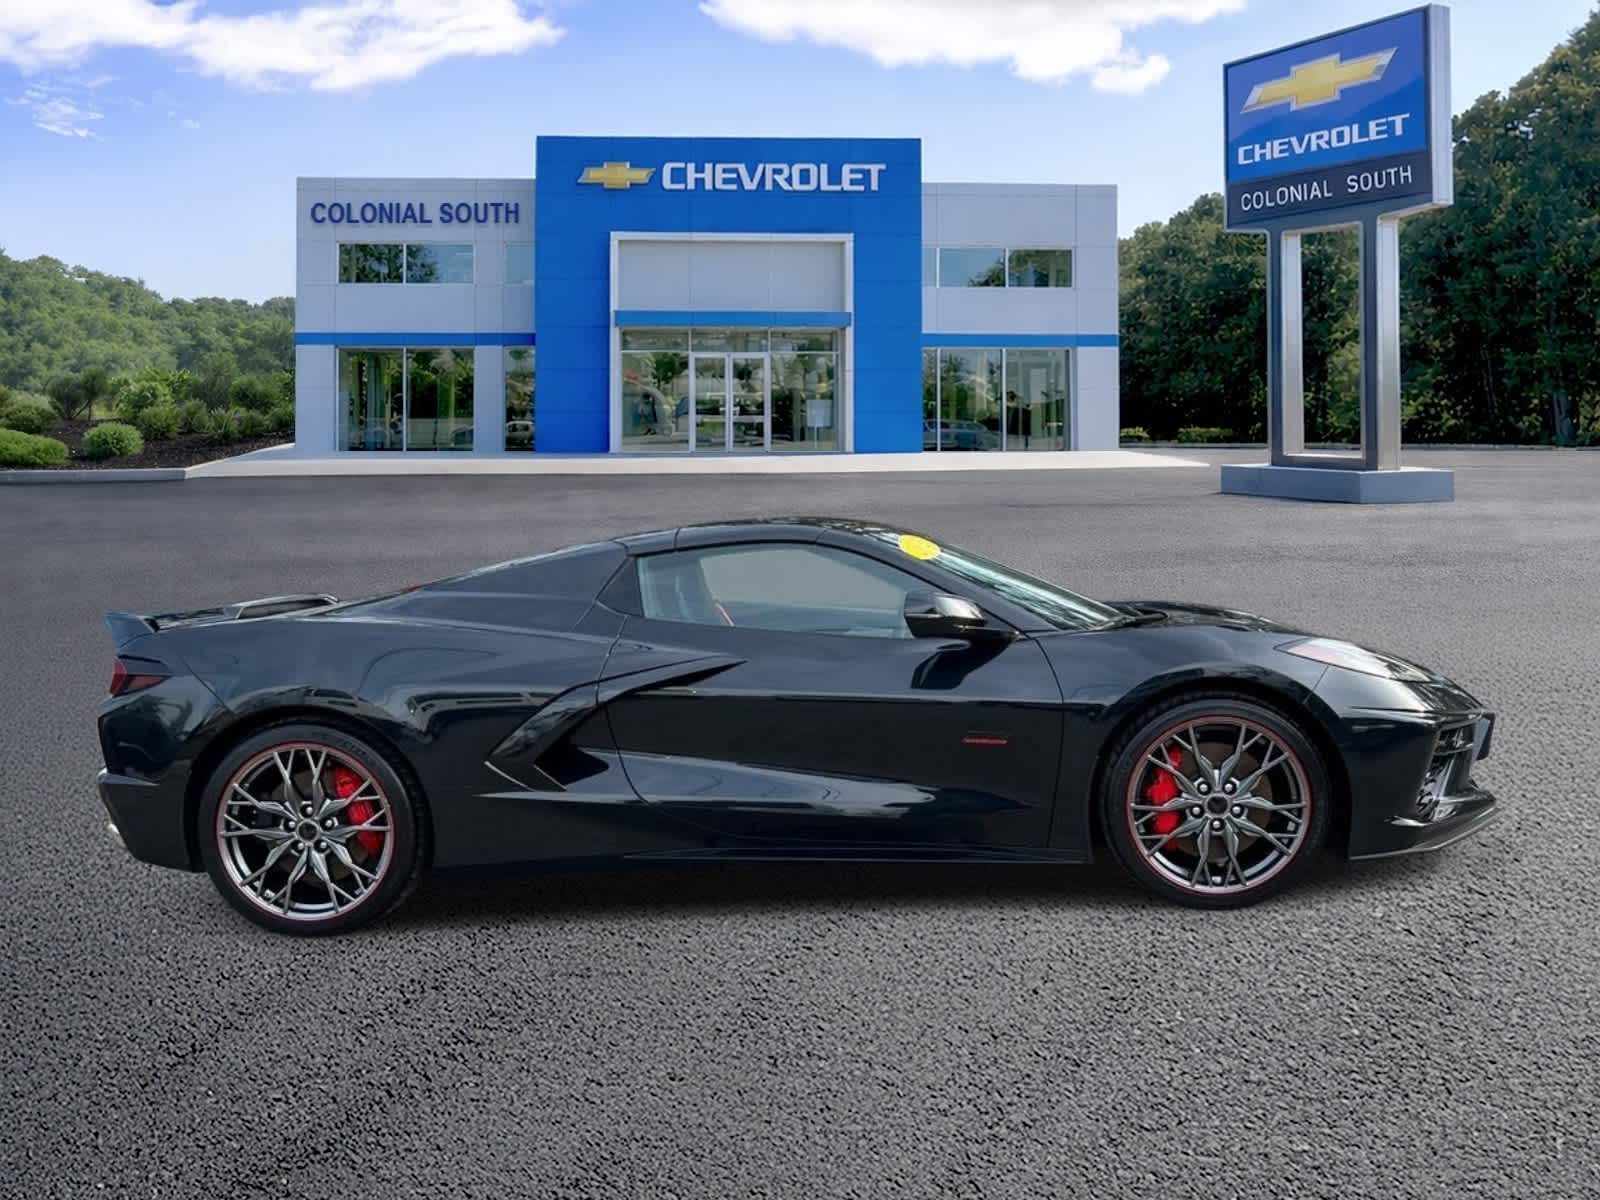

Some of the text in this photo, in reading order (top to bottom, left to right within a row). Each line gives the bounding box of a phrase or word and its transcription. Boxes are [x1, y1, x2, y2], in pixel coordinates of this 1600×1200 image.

[1237, 113, 1410, 165] CHEVROLET
[662, 162, 886, 191] CHEVROLET
[1240, 165, 1412, 211] COLONIAL SOUTH
[310, 202, 520, 224] COLONIAL SOUTH
